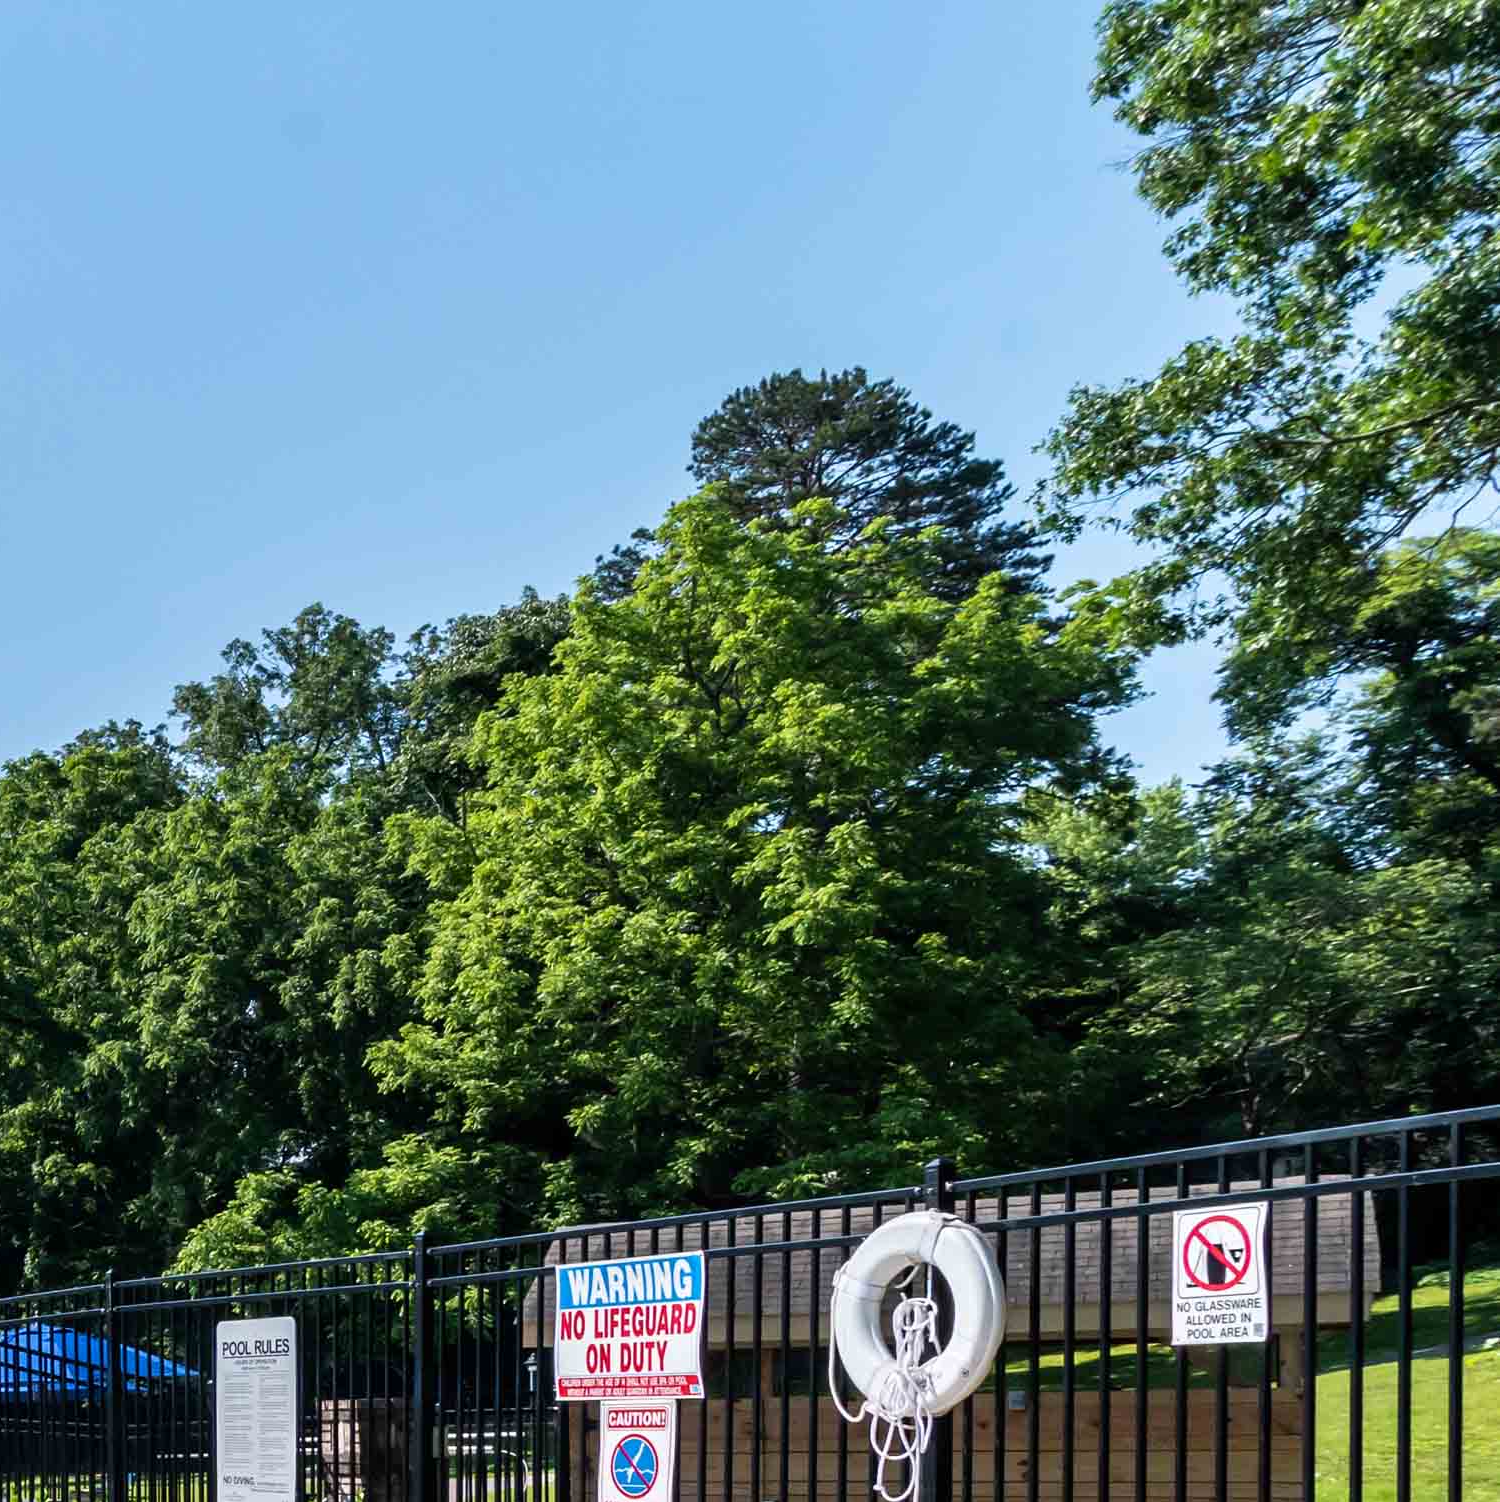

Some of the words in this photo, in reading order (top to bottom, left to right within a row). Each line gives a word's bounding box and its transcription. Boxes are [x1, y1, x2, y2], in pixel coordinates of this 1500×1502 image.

[567, 1259, 693, 1306] WARNING
[1177, 1302, 1191, 1313] NO
[1195, 1298, 1262, 1312] GLASSWARE
[560, 1310, 585, 1340] NO
[594, 1303, 697, 1339] LIFEGUARD
[1185, 1313, 1237, 1326] ALLOWED
[1241, 1312, 1252, 1322] IN
[1187, 1328, 1215, 1339] POOL
[1220, 1326, 1249, 1338] AREA
[222, 1341, 251, 1356] POOL
[254, 1338, 290, 1354] RULES
[586, 1343, 611, 1374] ON
[620, 1341, 667, 1373] DUTY
[609, 1411, 665, 1427] CAUTION!
